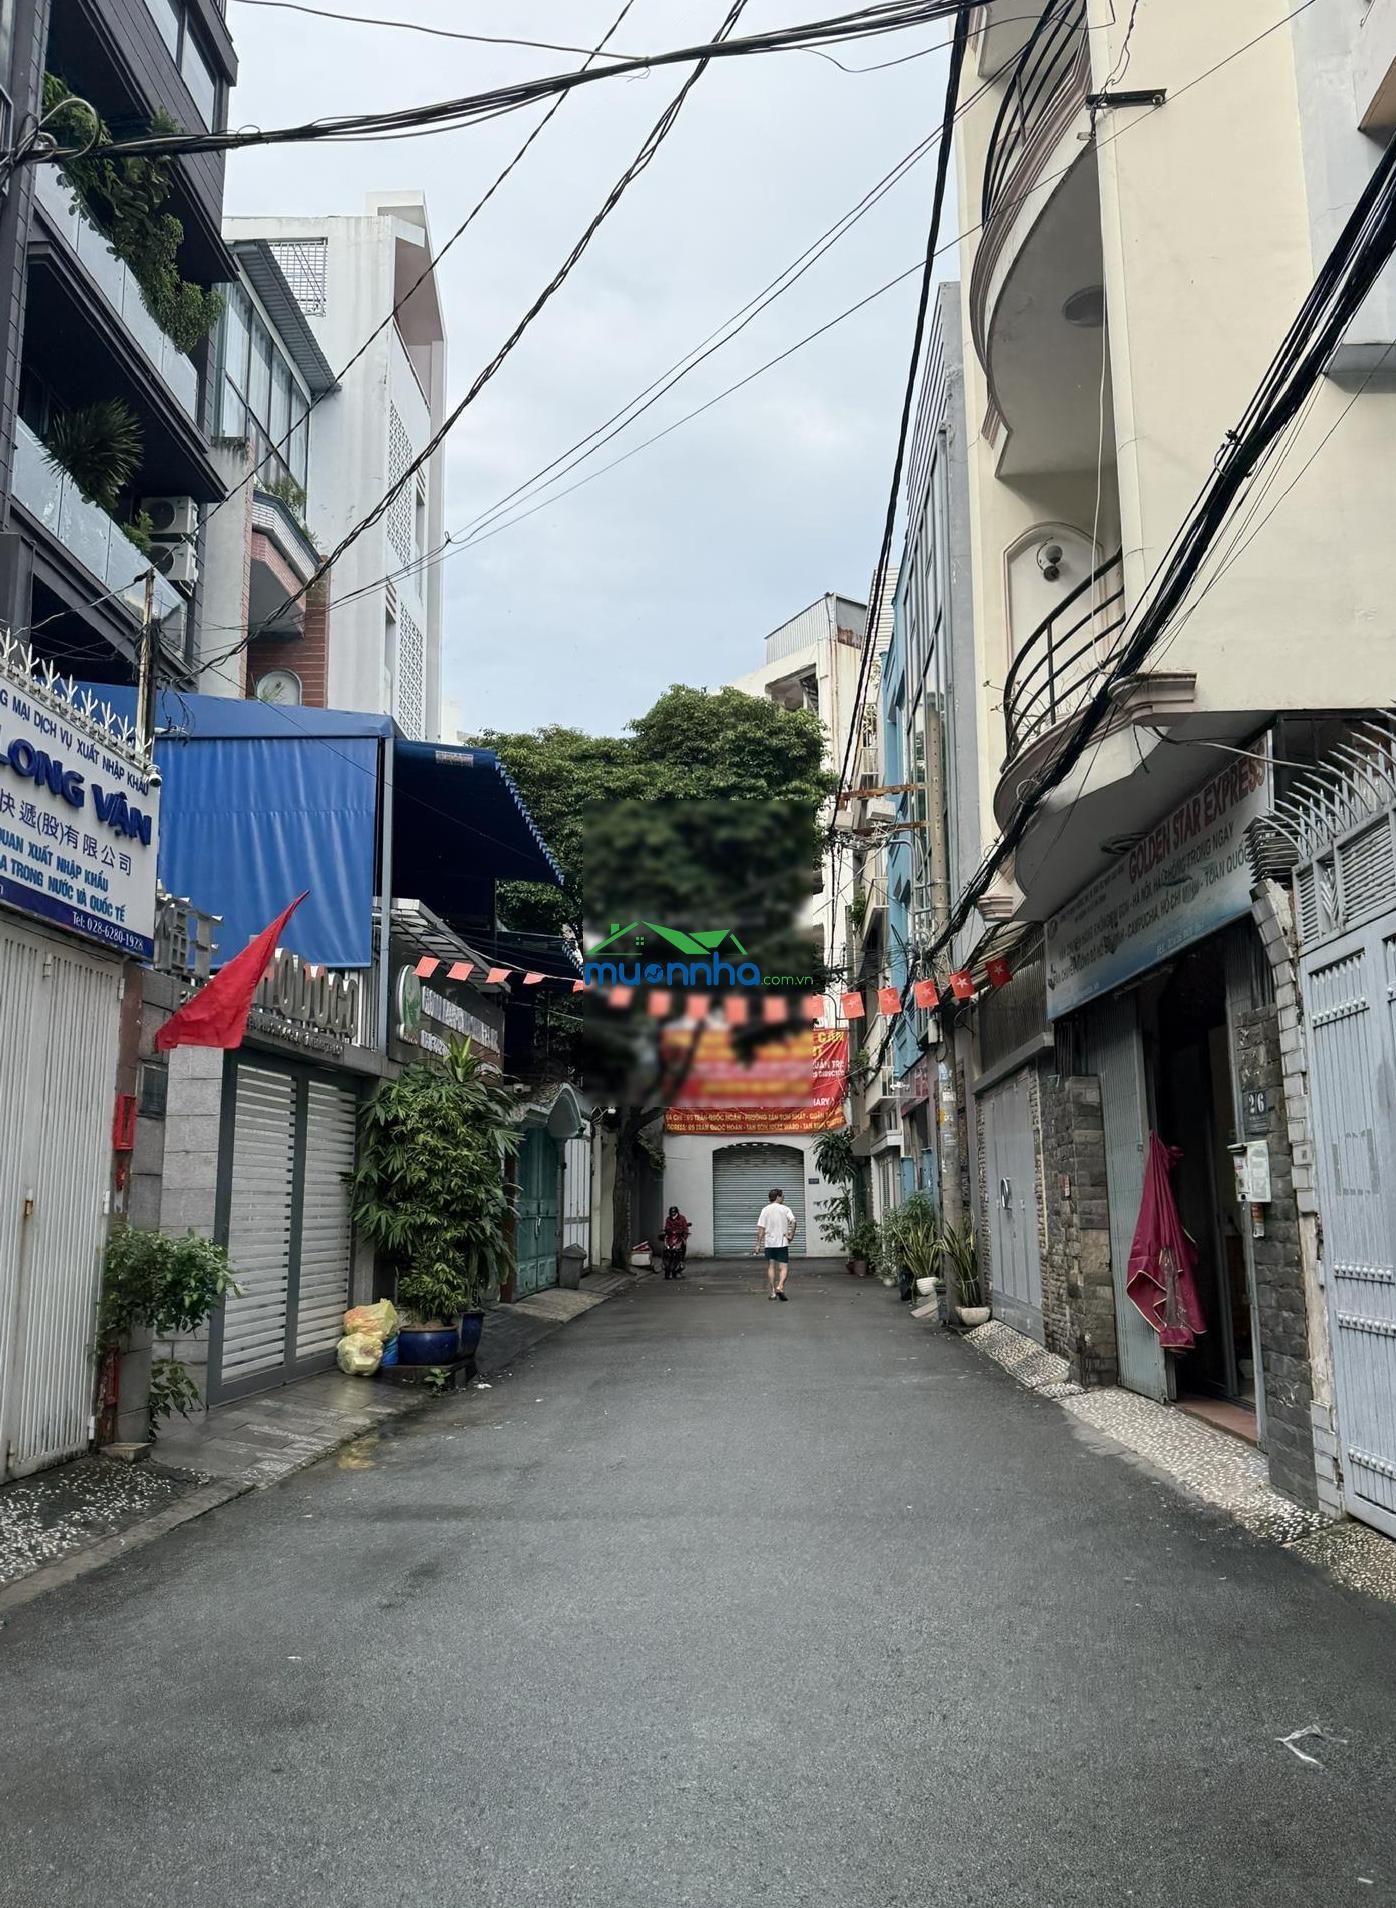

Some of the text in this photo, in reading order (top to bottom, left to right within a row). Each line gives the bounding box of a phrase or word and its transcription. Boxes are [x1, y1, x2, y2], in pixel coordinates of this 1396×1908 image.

[13, 695, 31, 721] MẠI
[34, 710, 57, 738] DỊCH
[60, 728, 73, 751] VỤ
[77, 738, 100, 765] XUẤT
[102, 755, 125, 780] NHẬP
[91, 783, 152, 846] VẬN
[1129, 740, 1266, 884] GOLDEN STAR EXPRESS
[11, 858, 44, 887] TRONG
[48, 875, 74, 900] NƯỚC
[76, 888, 87, 907] VÀ
[90, 894, 114, 917] QUỐC
[115, 903, 126, 922] TẾ
[28, 841, 53, 867] XUẤT
[57, 855, 82, 880] NHẬP
[72, 911, 85, 928] Tel:
